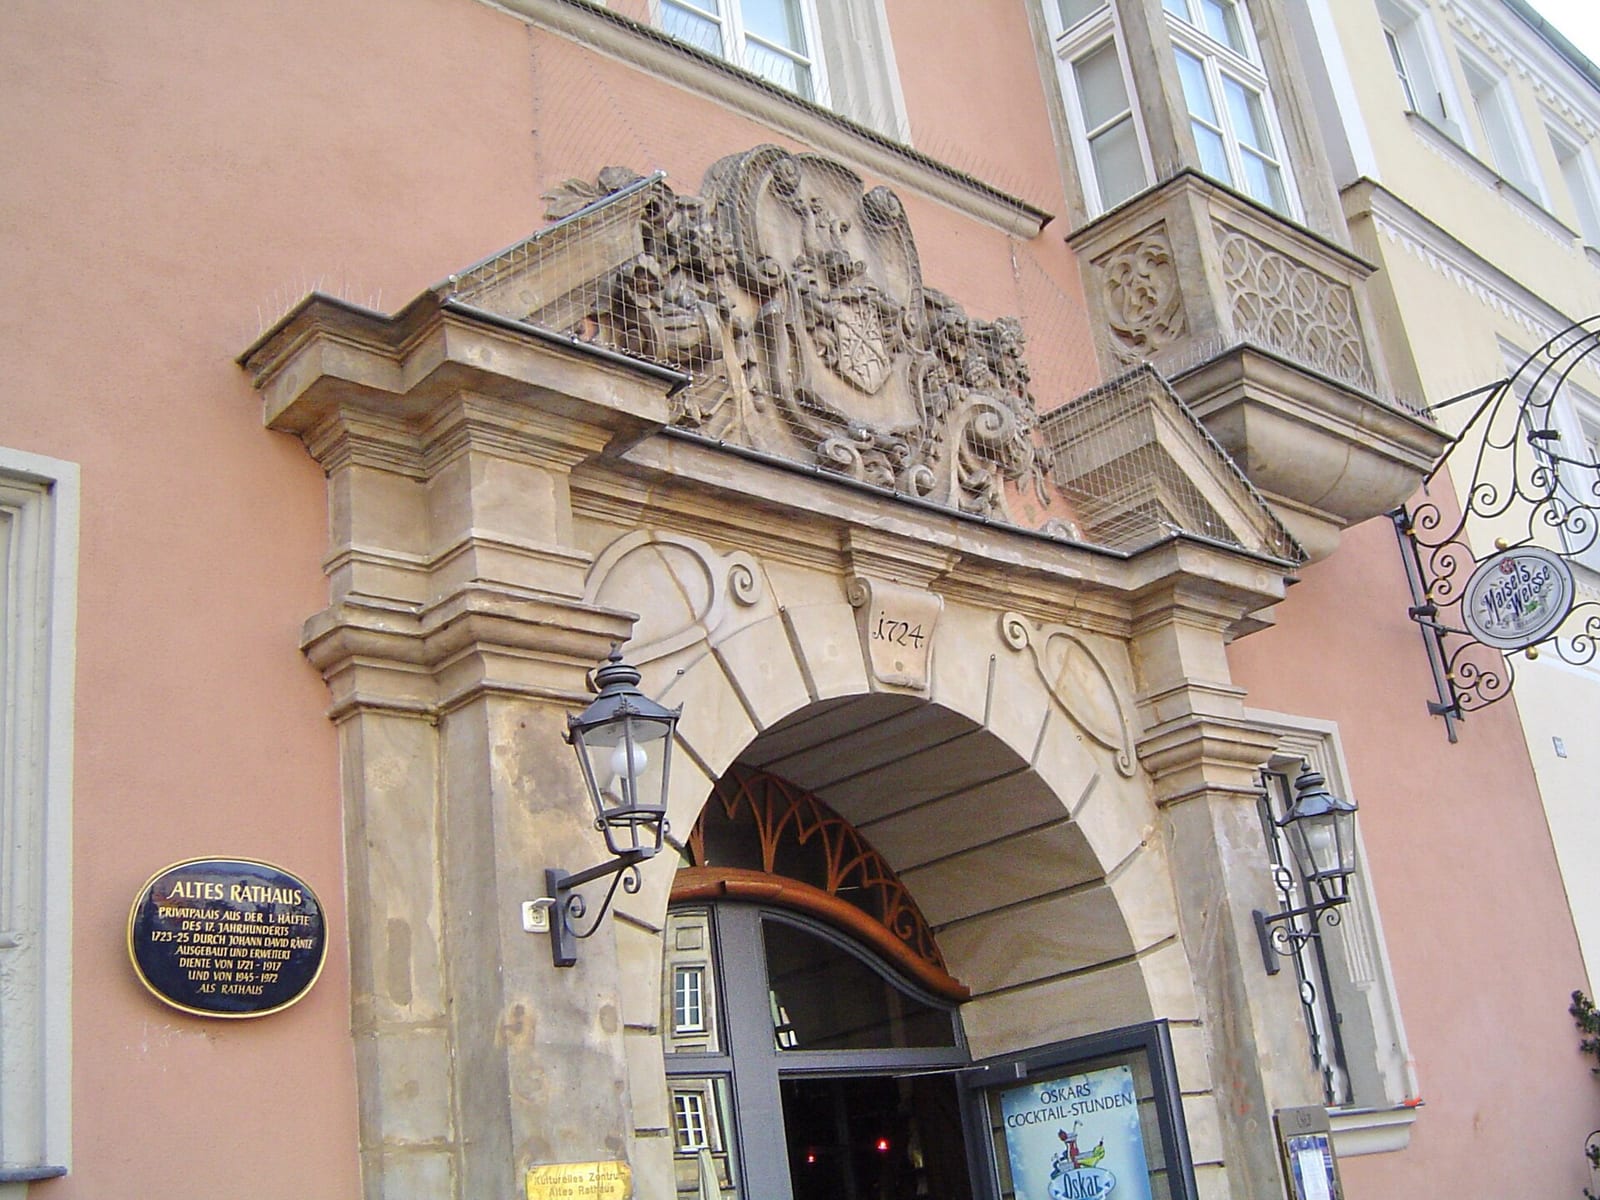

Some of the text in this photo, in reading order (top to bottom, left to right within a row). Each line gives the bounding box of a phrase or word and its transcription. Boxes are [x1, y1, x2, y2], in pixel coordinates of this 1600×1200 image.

[1481, 561, 1531, 629] Maisel's
[1506, 565, 1550, 617] Weisse
[166, 881, 302, 905] ALTES RATHAUS
[158, 906, 220, 920] PRIVATPALAIS
[221, 910, 241, 921] AUS
[244, 912, 263, 923] DER
[278, 912, 310, 926] HÄLFTE
[182, 920, 290, 936] DES 17. JAHRHUNDERTS
[151, 931, 313, 950] 1723-25 DURCH JOHANN DAVID RÄNTZ
[174, 945, 291, 960] AUSGEBAUT UND ERWEITERT
[179, 957, 211, 968] DIENTE
[214, 959, 233, 969] VON
[237, 960, 254, 970] 1721
[262, 961, 282, 972] 1917
[188, 970, 210, 981] UND
[213, 971, 232, 981] VON
[196, 983, 263, 995] ALS RATHAUS
[1040, 1082, 1091, 1105] OSKARS
[1007, 1092, 1133, 1128] COCKTAIL-STUNDEN
[534, 1175, 584, 1186] Kulturelles
[1062, 1170, 1100, 1200] Oskar
[549, 1184, 615, 1197] Altes Rathaus
